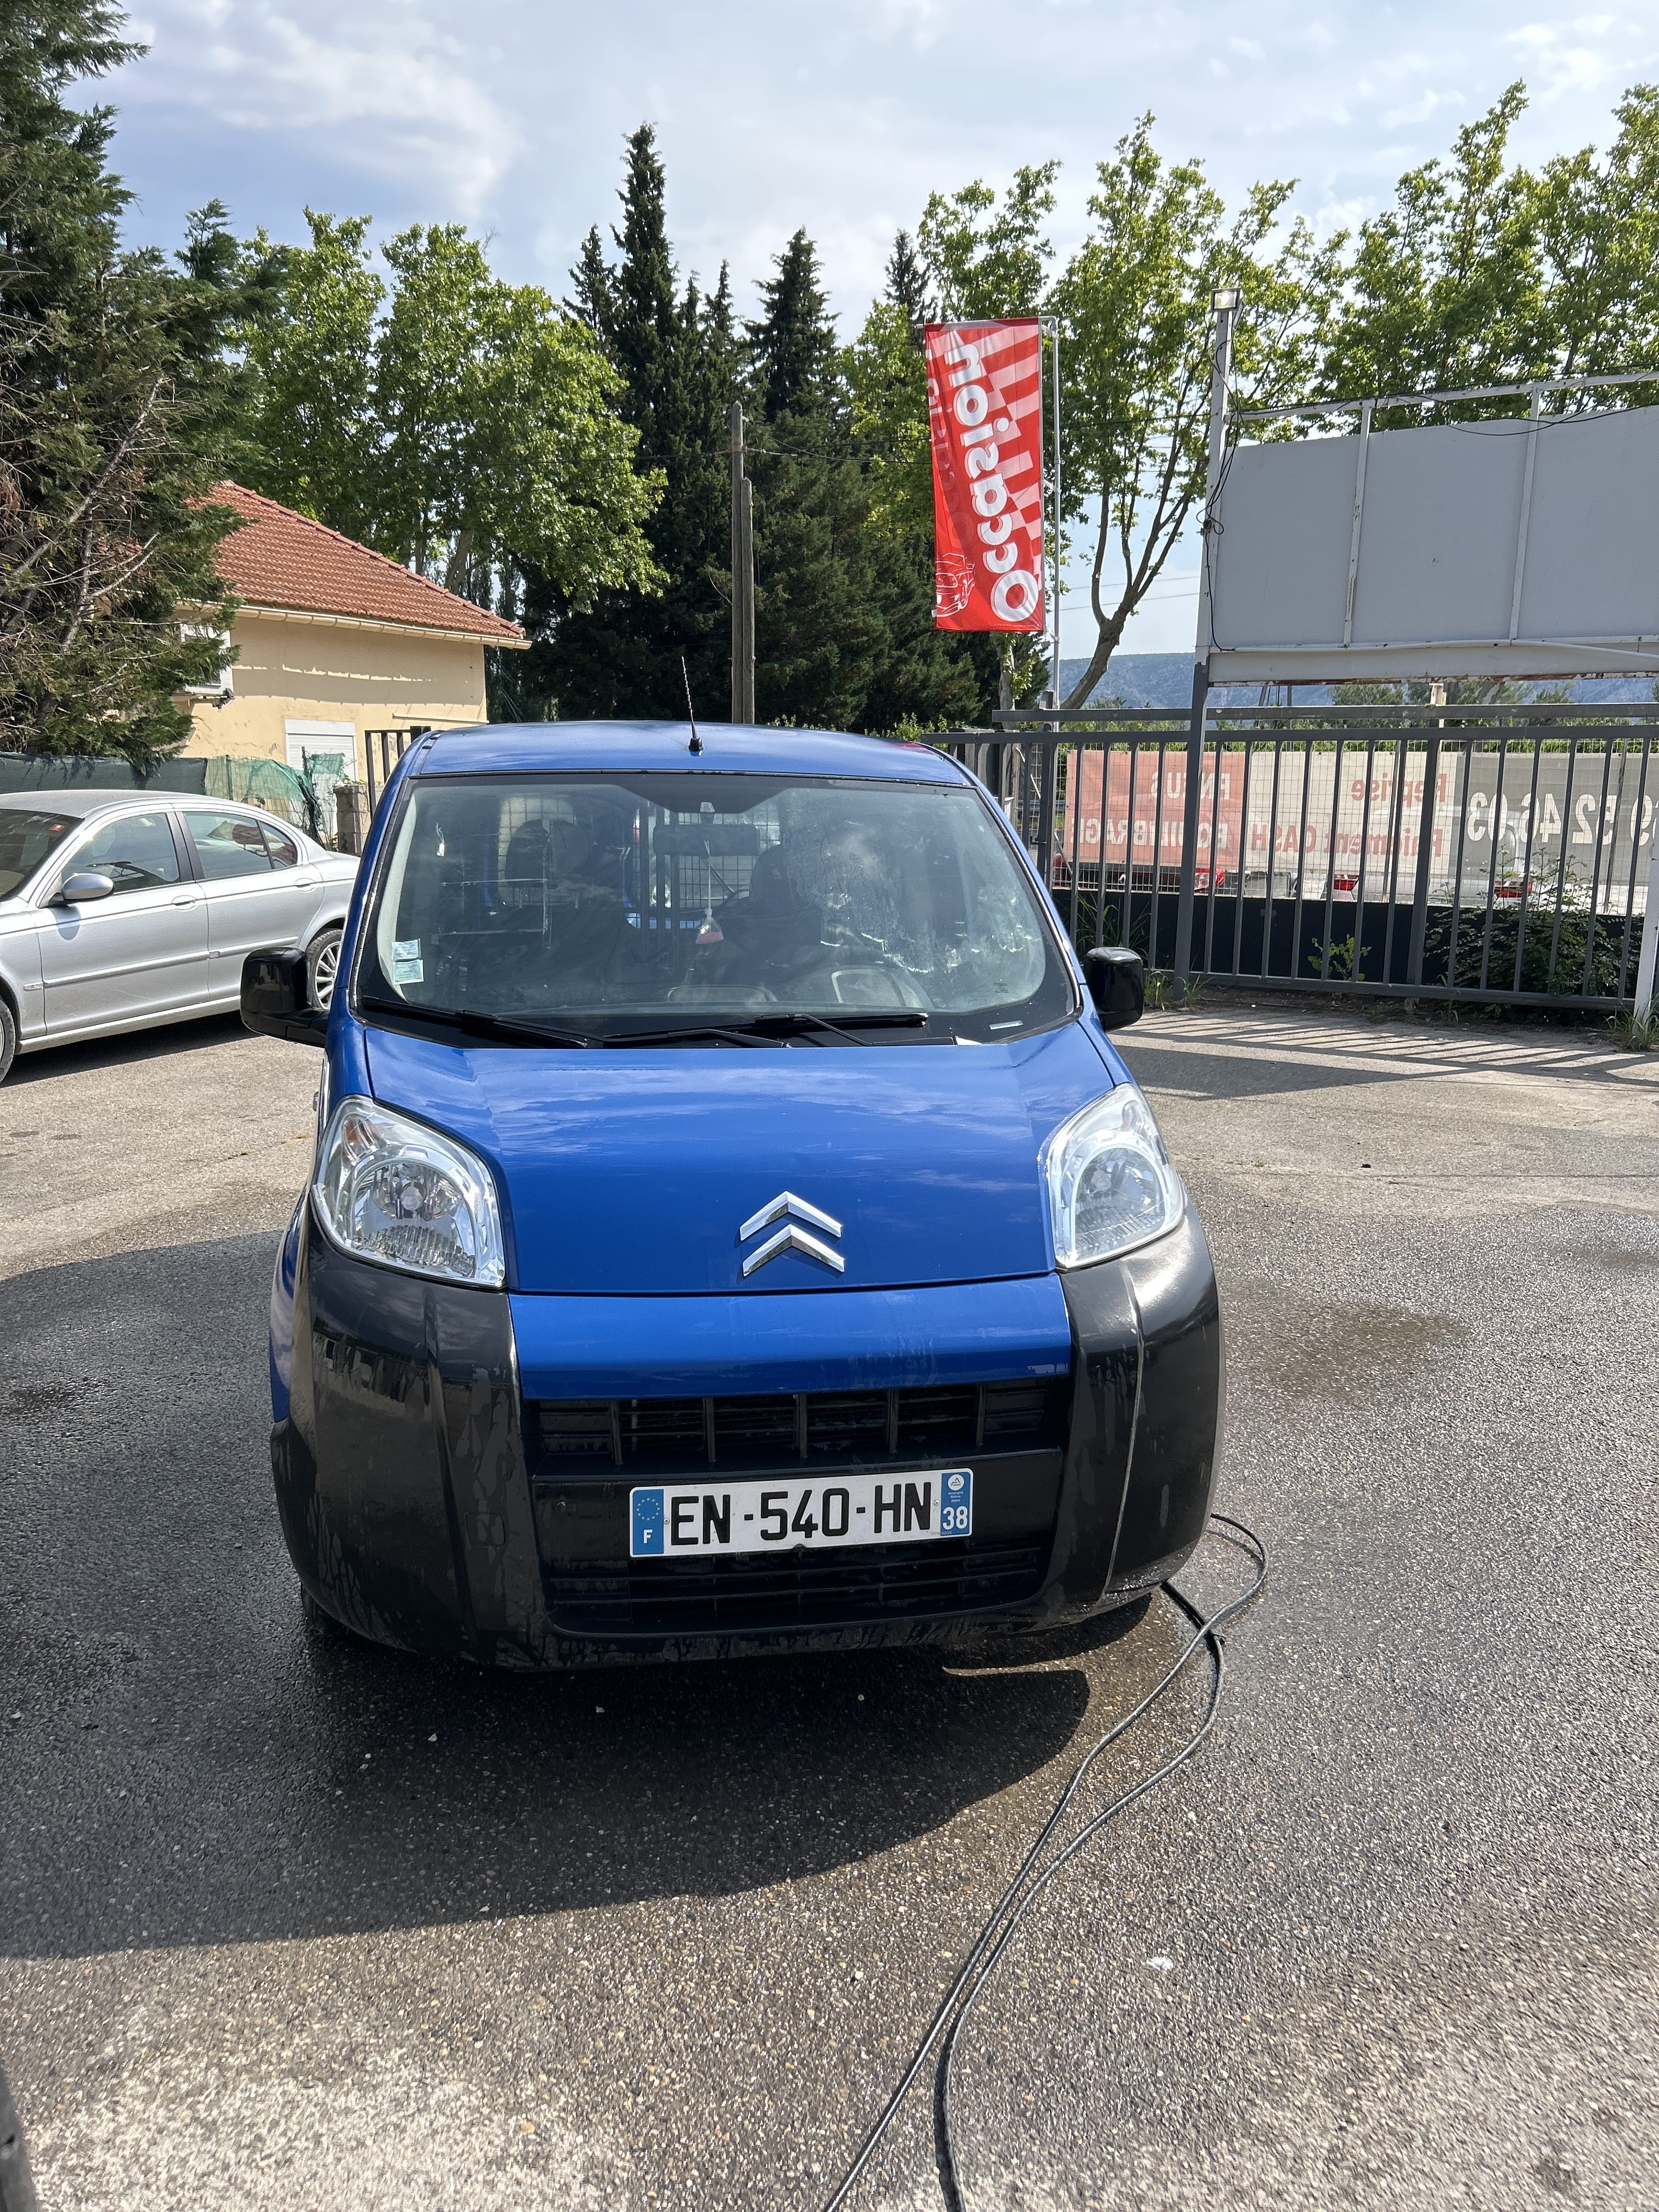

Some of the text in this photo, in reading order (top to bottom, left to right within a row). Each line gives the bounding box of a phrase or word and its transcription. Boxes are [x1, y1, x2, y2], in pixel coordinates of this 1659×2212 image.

[671, 1482, 932, 1545] EN-540-HN
[943, 1505, 968, 1530] 38
[643, 1529, 653, 1544] F
